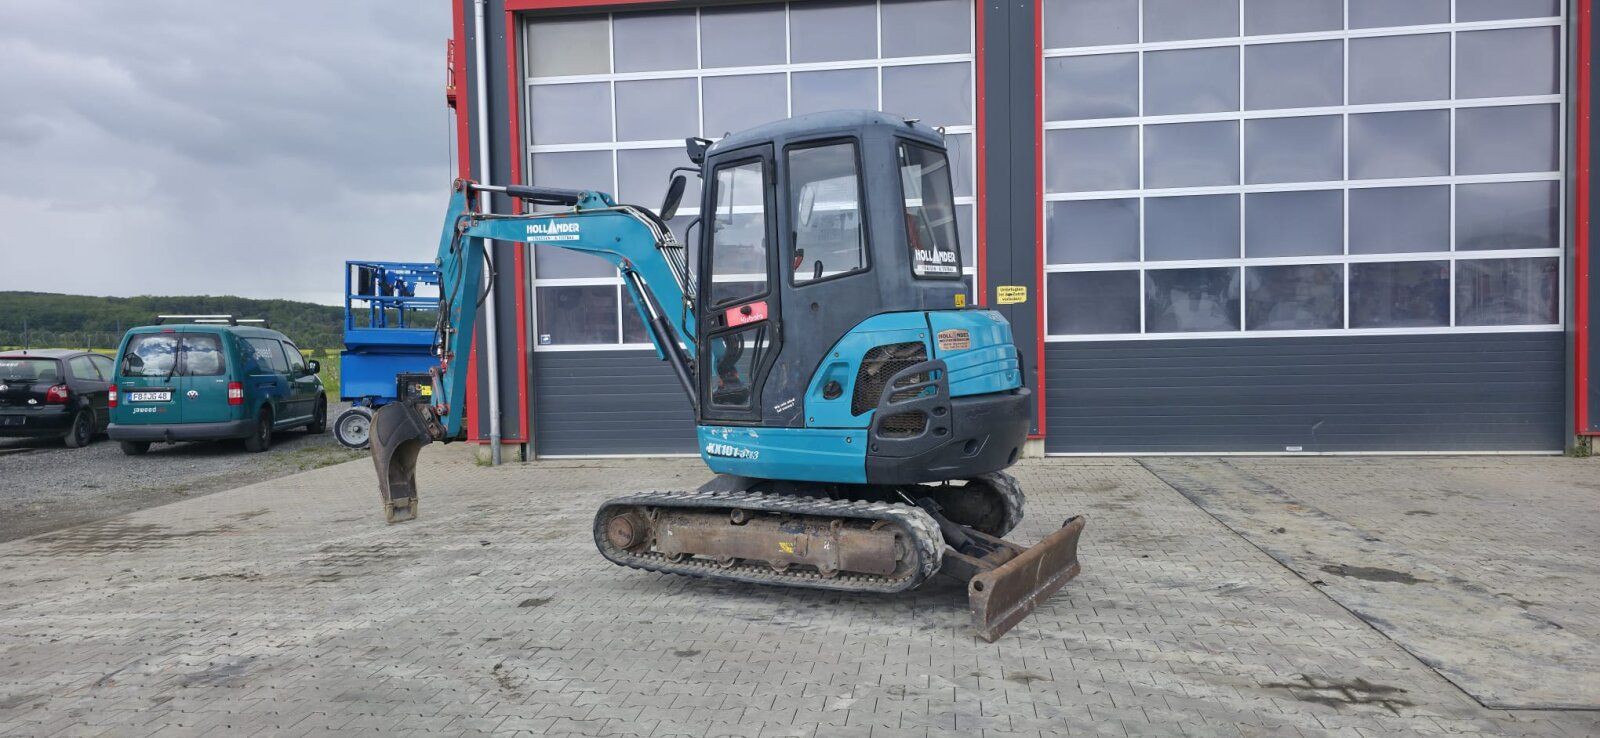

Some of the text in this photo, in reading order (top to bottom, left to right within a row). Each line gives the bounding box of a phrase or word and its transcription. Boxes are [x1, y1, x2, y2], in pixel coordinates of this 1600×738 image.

[526, 218, 580, 235] HOLLANDER
[914, 245, 956, 264] HOLLANDER
[740, 313, 764, 322] Kubota
